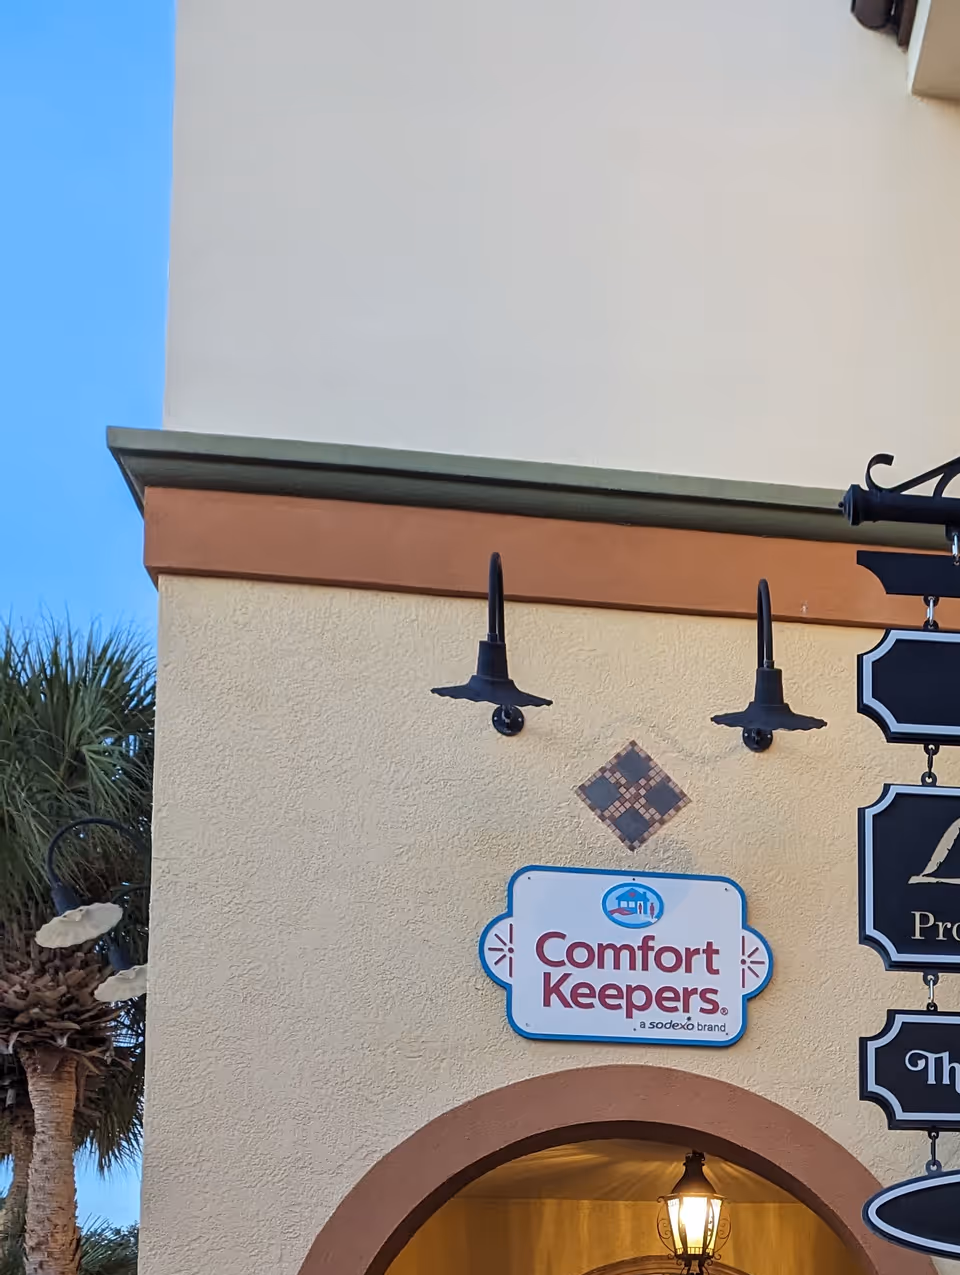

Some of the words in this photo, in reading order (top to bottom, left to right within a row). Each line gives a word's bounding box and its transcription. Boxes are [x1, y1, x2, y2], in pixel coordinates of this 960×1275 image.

[535, 931, 720, 975] Comfort
[639, 1020, 646, 1029] a
[648, 1020, 695, 1032] sodexo
[697, 1022, 726, 1033] brand
